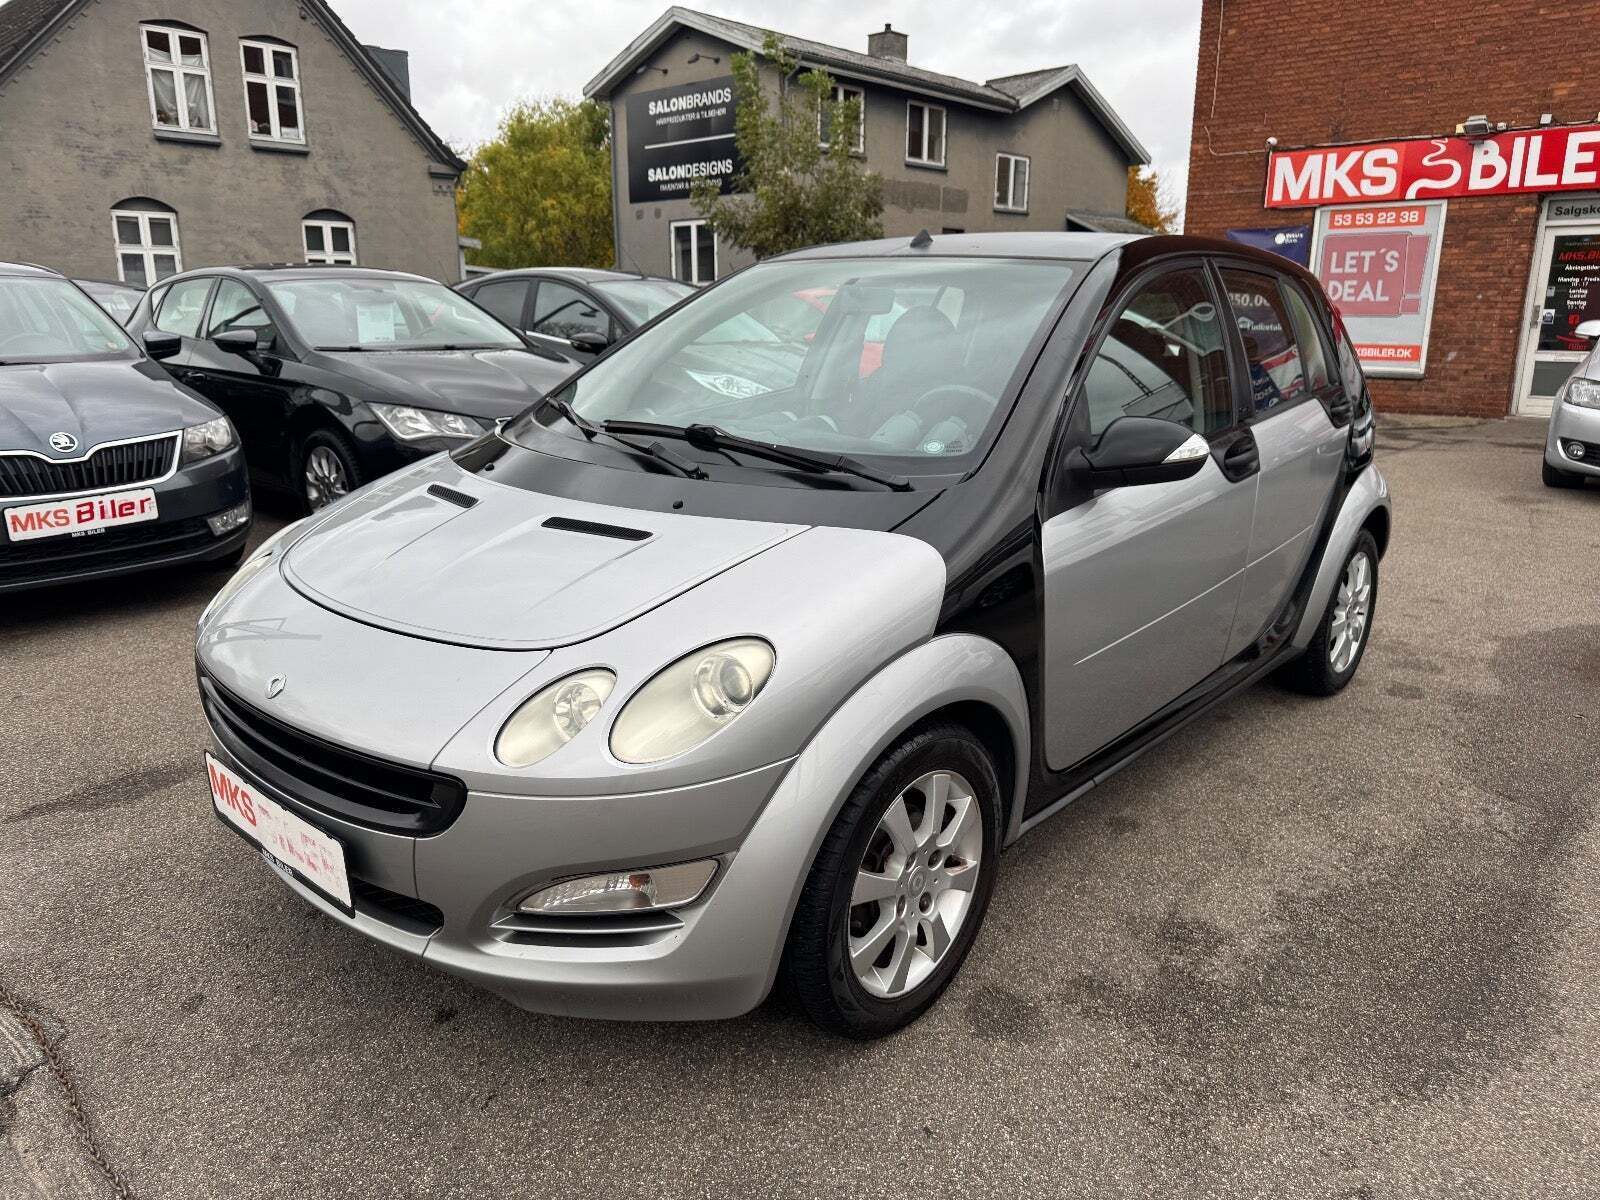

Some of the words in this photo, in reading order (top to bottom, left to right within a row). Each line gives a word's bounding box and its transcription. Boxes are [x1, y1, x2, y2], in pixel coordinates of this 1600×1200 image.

[648, 87, 732, 116] SALONBRANDS
[647, 158, 734, 182] SALONDESIGNS
[1271, 148, 1399, 202] MKS
[1468, 130, 1600, 191] BILE
[1333, 213, 1352, 226] 53
[1355, 212, 1374, 225] 53
[1377, 211, 1396, 224] 22
[1400, 210, 1419, 223] 38
[1327, 279, 1390, 302] DEAL
[10, 507, 71, 533] MKS
[76, 497, 153, 524] Biler
[208, 763, 257, 827] MKS
